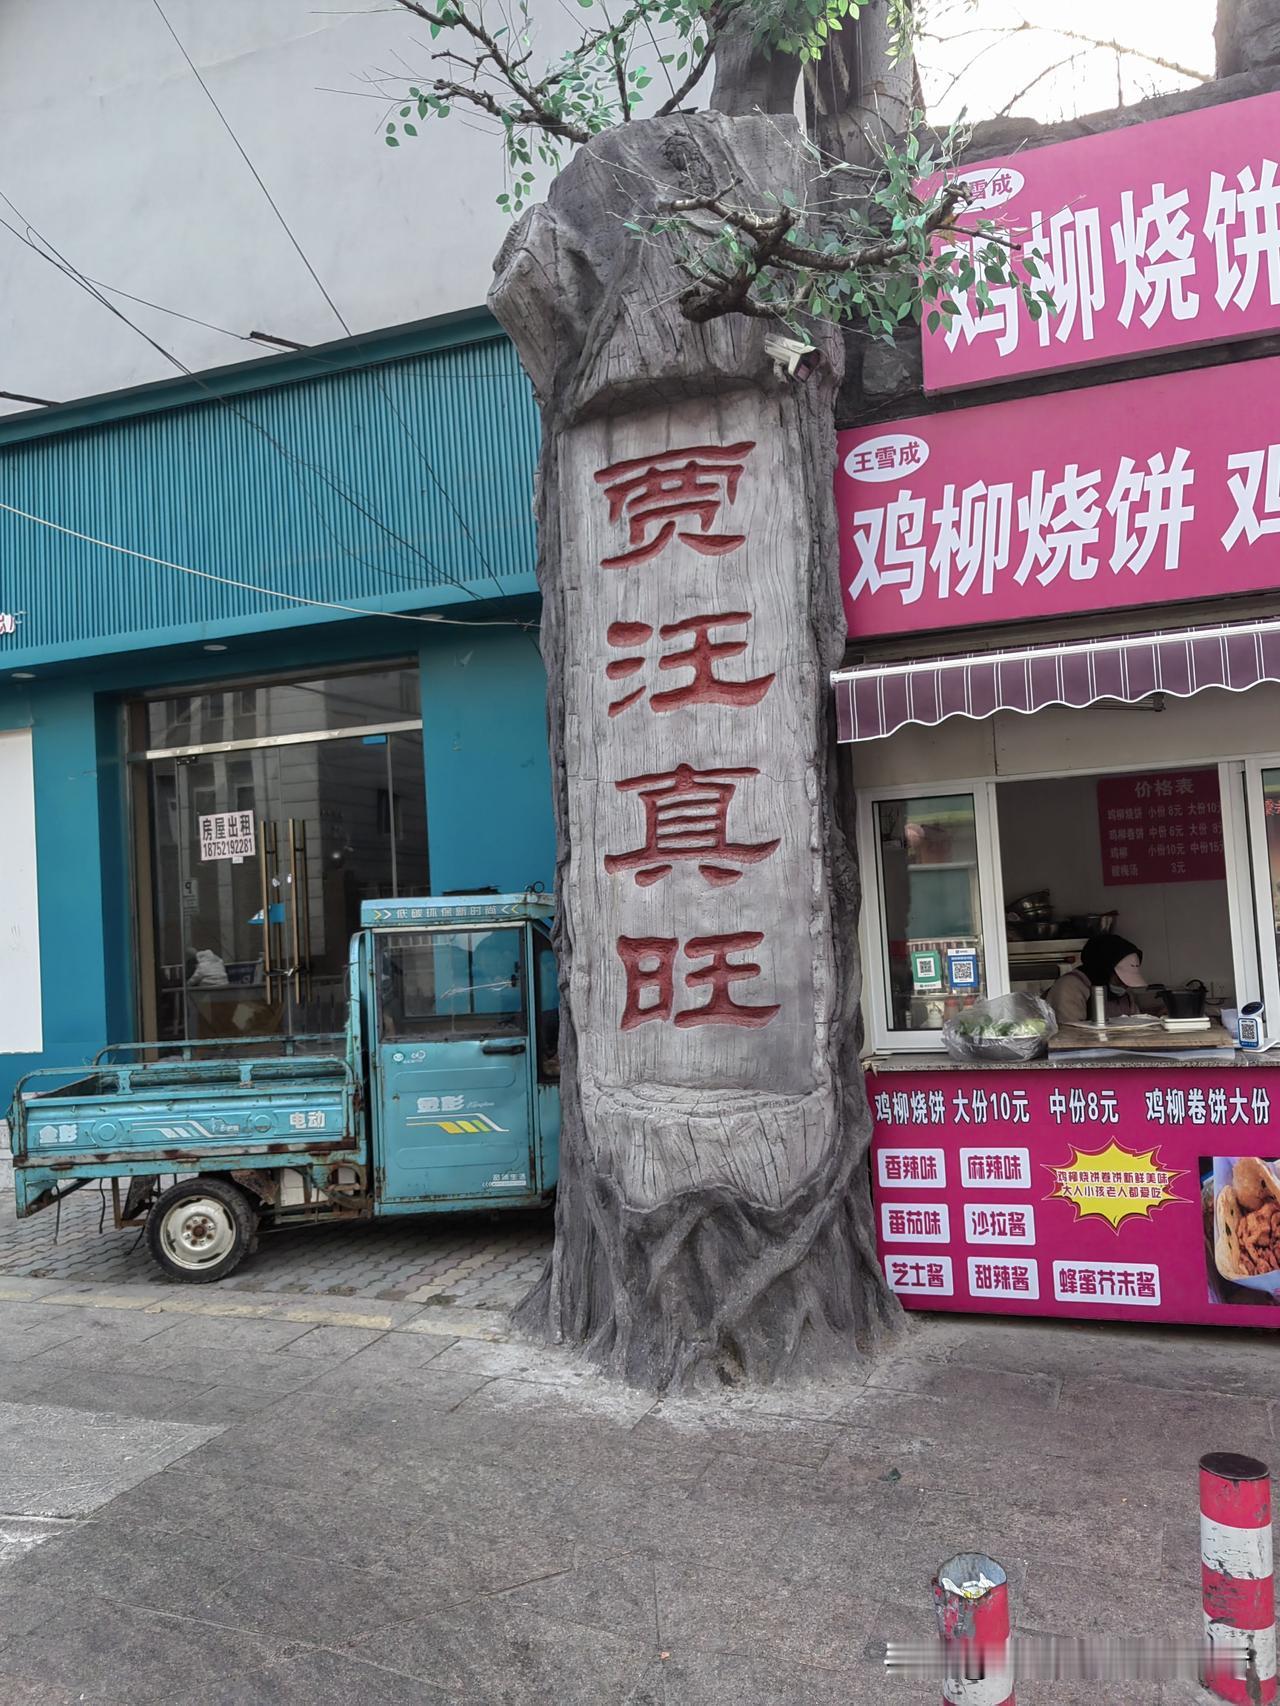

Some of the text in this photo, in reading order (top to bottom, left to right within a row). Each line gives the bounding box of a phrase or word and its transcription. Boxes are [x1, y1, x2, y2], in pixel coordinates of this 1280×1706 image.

[955, 173, 1013, 201] 雪成
[941, 158, 1280, 357] 鸡柳烧饼
[852, 440, 921, 473] 王雪成
[848, 446, 1196, 605] 鸡柳烧饼
[592, 440, 782, 1033] 贾汪真旺
[1135, 778, 1194, 798] 价格表
[203, 814, 252, 841] 房屋出租
[203, 838, 253, 857] 18752192281
[396, 904, 497, 919] 低碳环保新时尚
[874, 1089, 946, 1124] 鸡柳烧饼
[951, 1088, 1030, 1124] 大份10元
[1049, 1087, 1119, 1124] 中份8元
[288, 1110, 326, 1130] 电动
[885, 1155, 938, 1180] 香辣味
[967, 1154, 1022, 1180] 麻辣味
[1057, 1171, 1168, 1185] 鸡柳烧饼卷饼新鲜美味
[1062, 1184, 1162, 1199] 大人小孩老人都爱吃
[888, 1209, 942, 1236] 番茄味
[971, 1211, 1027, 1237] 沙拉酱
[891, 1262, 945, 1289] 芝士酱
[975, 1263, 1030, 1292] 甜辣酱
[1059, 1267, 1156, 1298] 蜂蜜芥末酱
